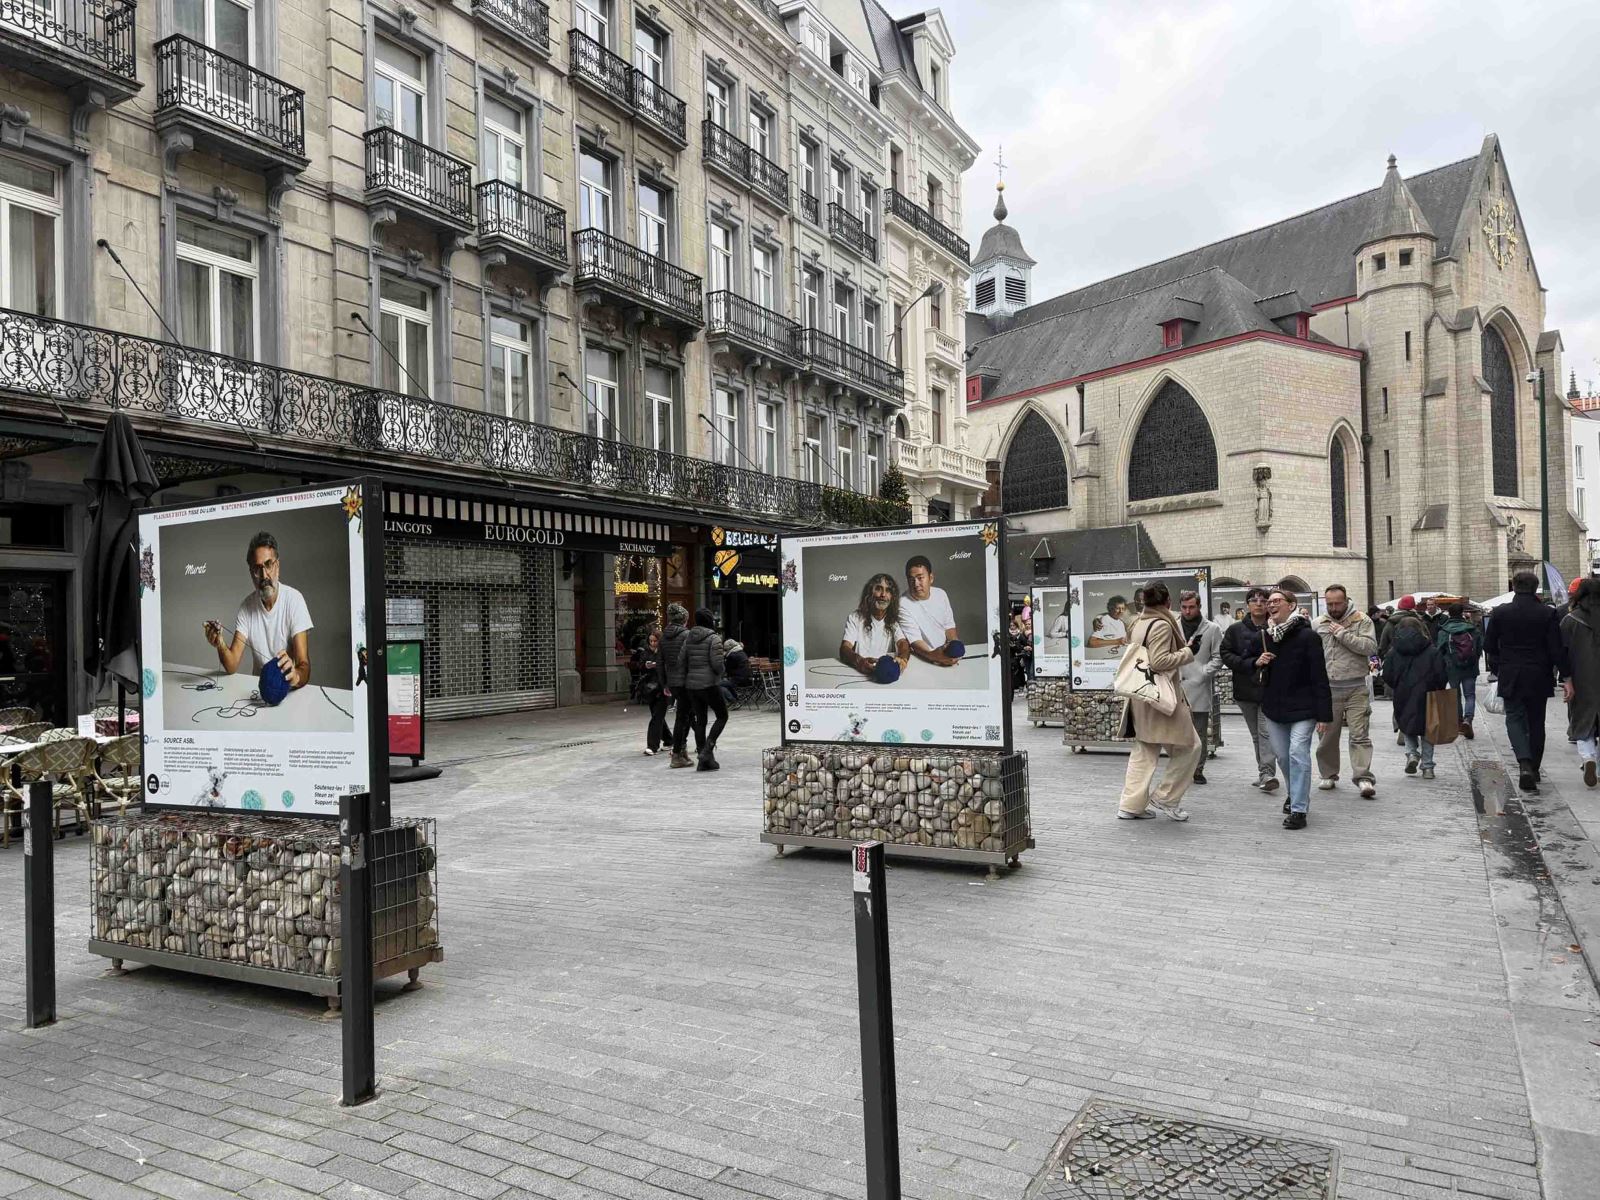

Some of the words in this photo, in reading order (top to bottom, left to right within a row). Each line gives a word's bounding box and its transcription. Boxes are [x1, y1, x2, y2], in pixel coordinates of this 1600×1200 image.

[276, 494, 293, 504] WINTER
[294, 493, 316, 502] WONDERS
[316, 489, 343, 498] CONNECTS
[384, 520, 432, 535] LINGOTS
[484, 524, 564, 546] EUROGOLD
[619, 542, 656, 554] EXCHANGE
[949, 550, 972, 561] Julien
[184, 562, 207, 576] Murat
[828, 573, 848, 582] Pierre
